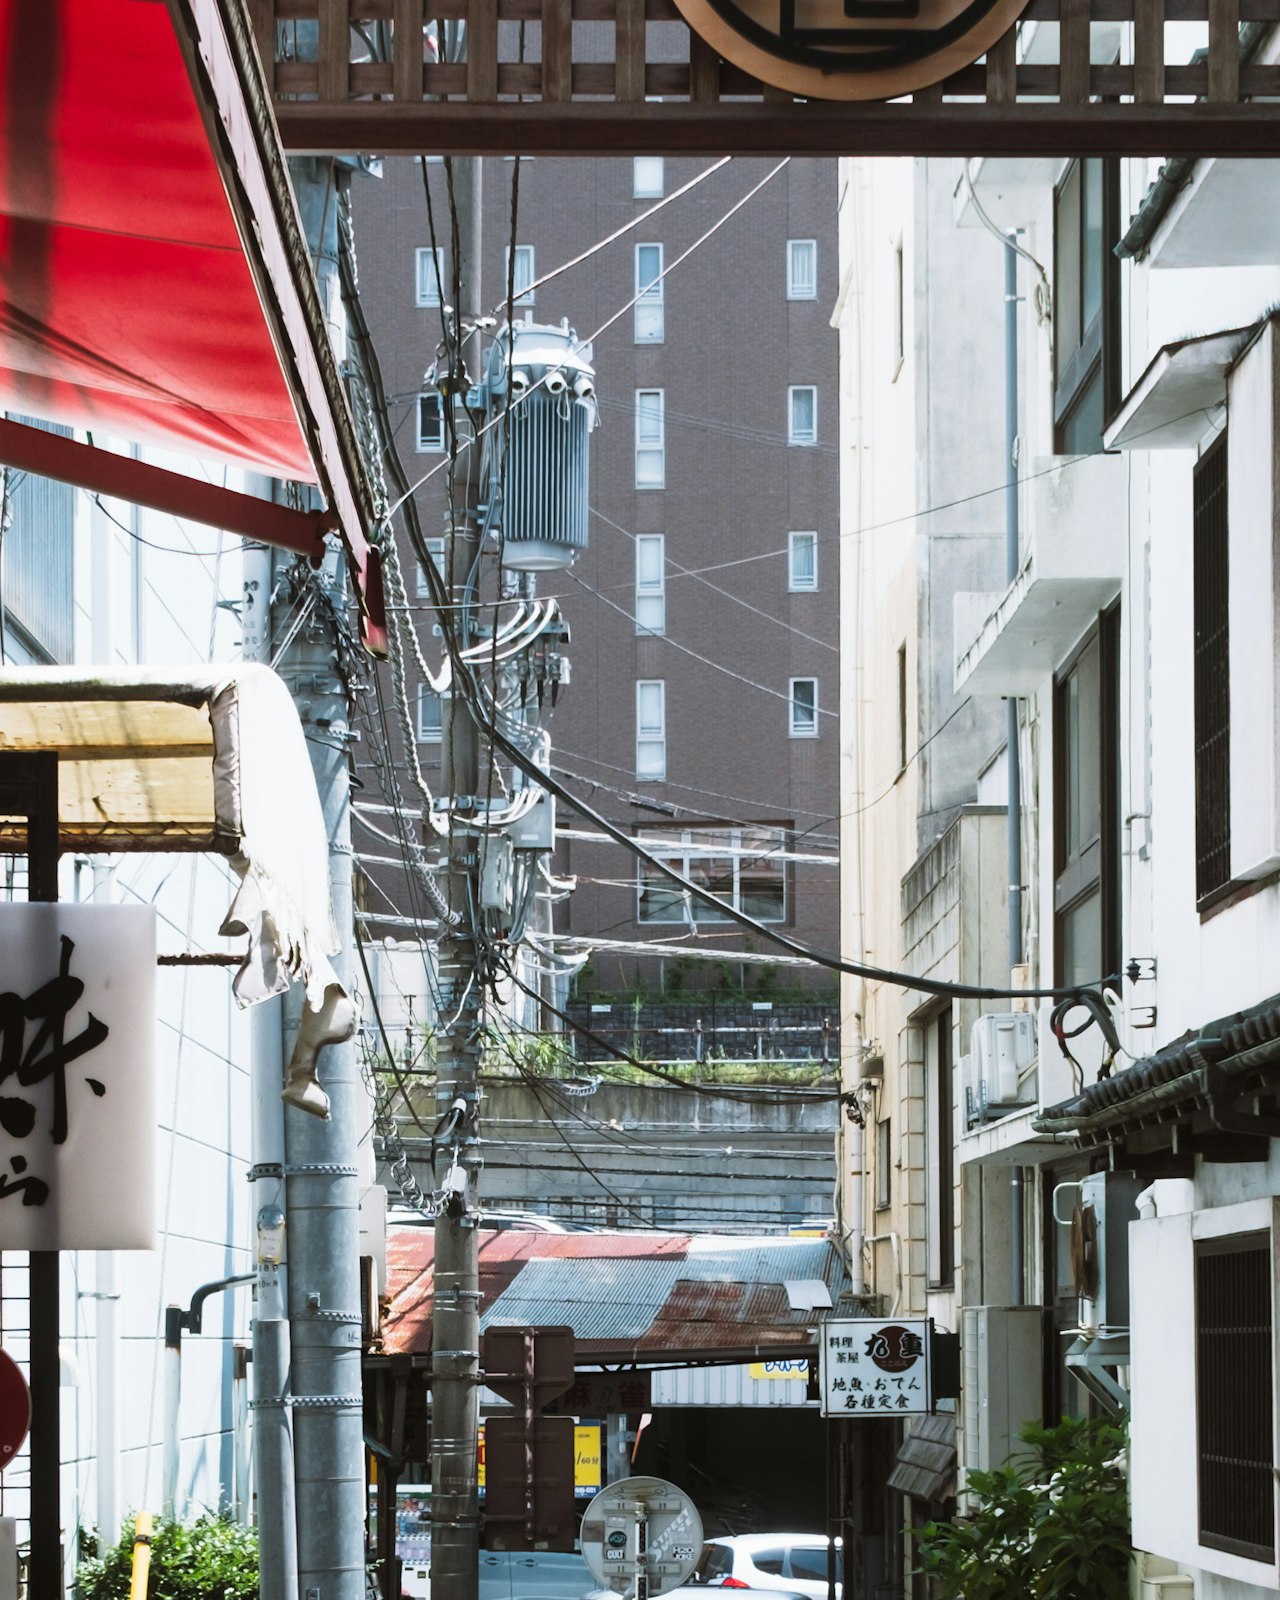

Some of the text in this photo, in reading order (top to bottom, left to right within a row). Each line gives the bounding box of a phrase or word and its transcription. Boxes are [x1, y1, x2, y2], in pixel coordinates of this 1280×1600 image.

[829, 1336, 853, 1349] 料理
[864, 1333, 924, 1358] 九重
[836, 1352, 860, 1364] 茶屋
[844, 1393, 910, 1409] 各種定食
